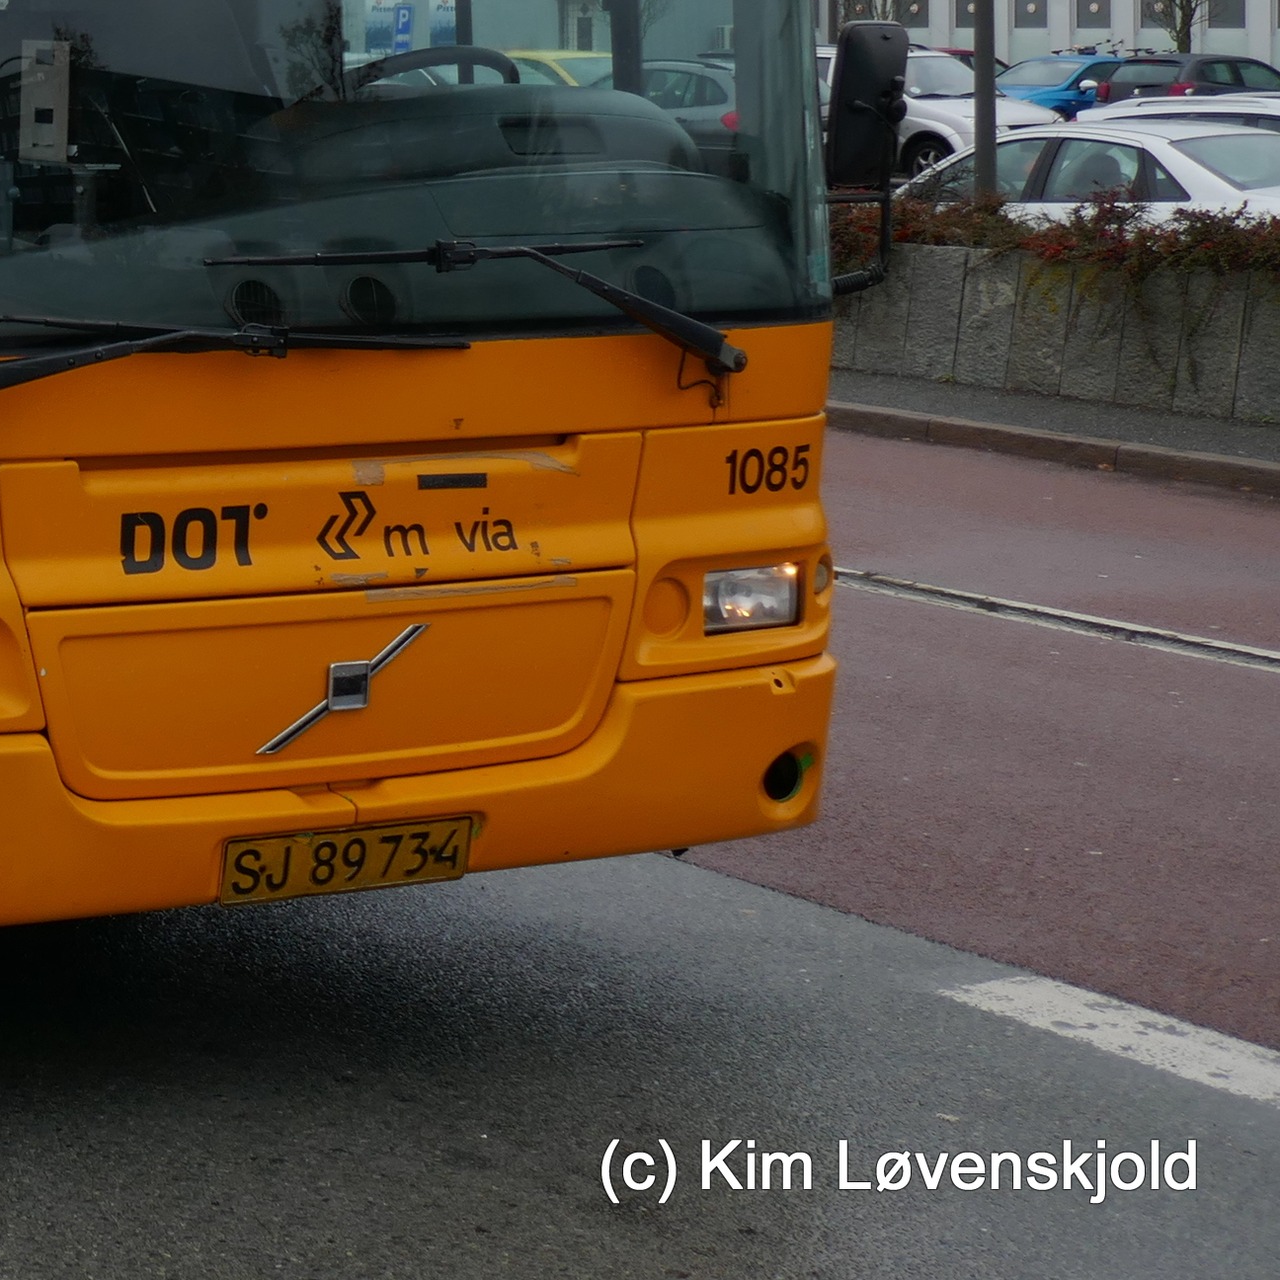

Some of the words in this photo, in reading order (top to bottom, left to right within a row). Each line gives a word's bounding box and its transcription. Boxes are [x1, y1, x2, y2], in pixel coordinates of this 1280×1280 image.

[725, 444, 810, 495] 1085
[120, 504, 268, 575] DOT
[231, 845, 292, 896] SJ
[310, 837, 367, 885] 89
